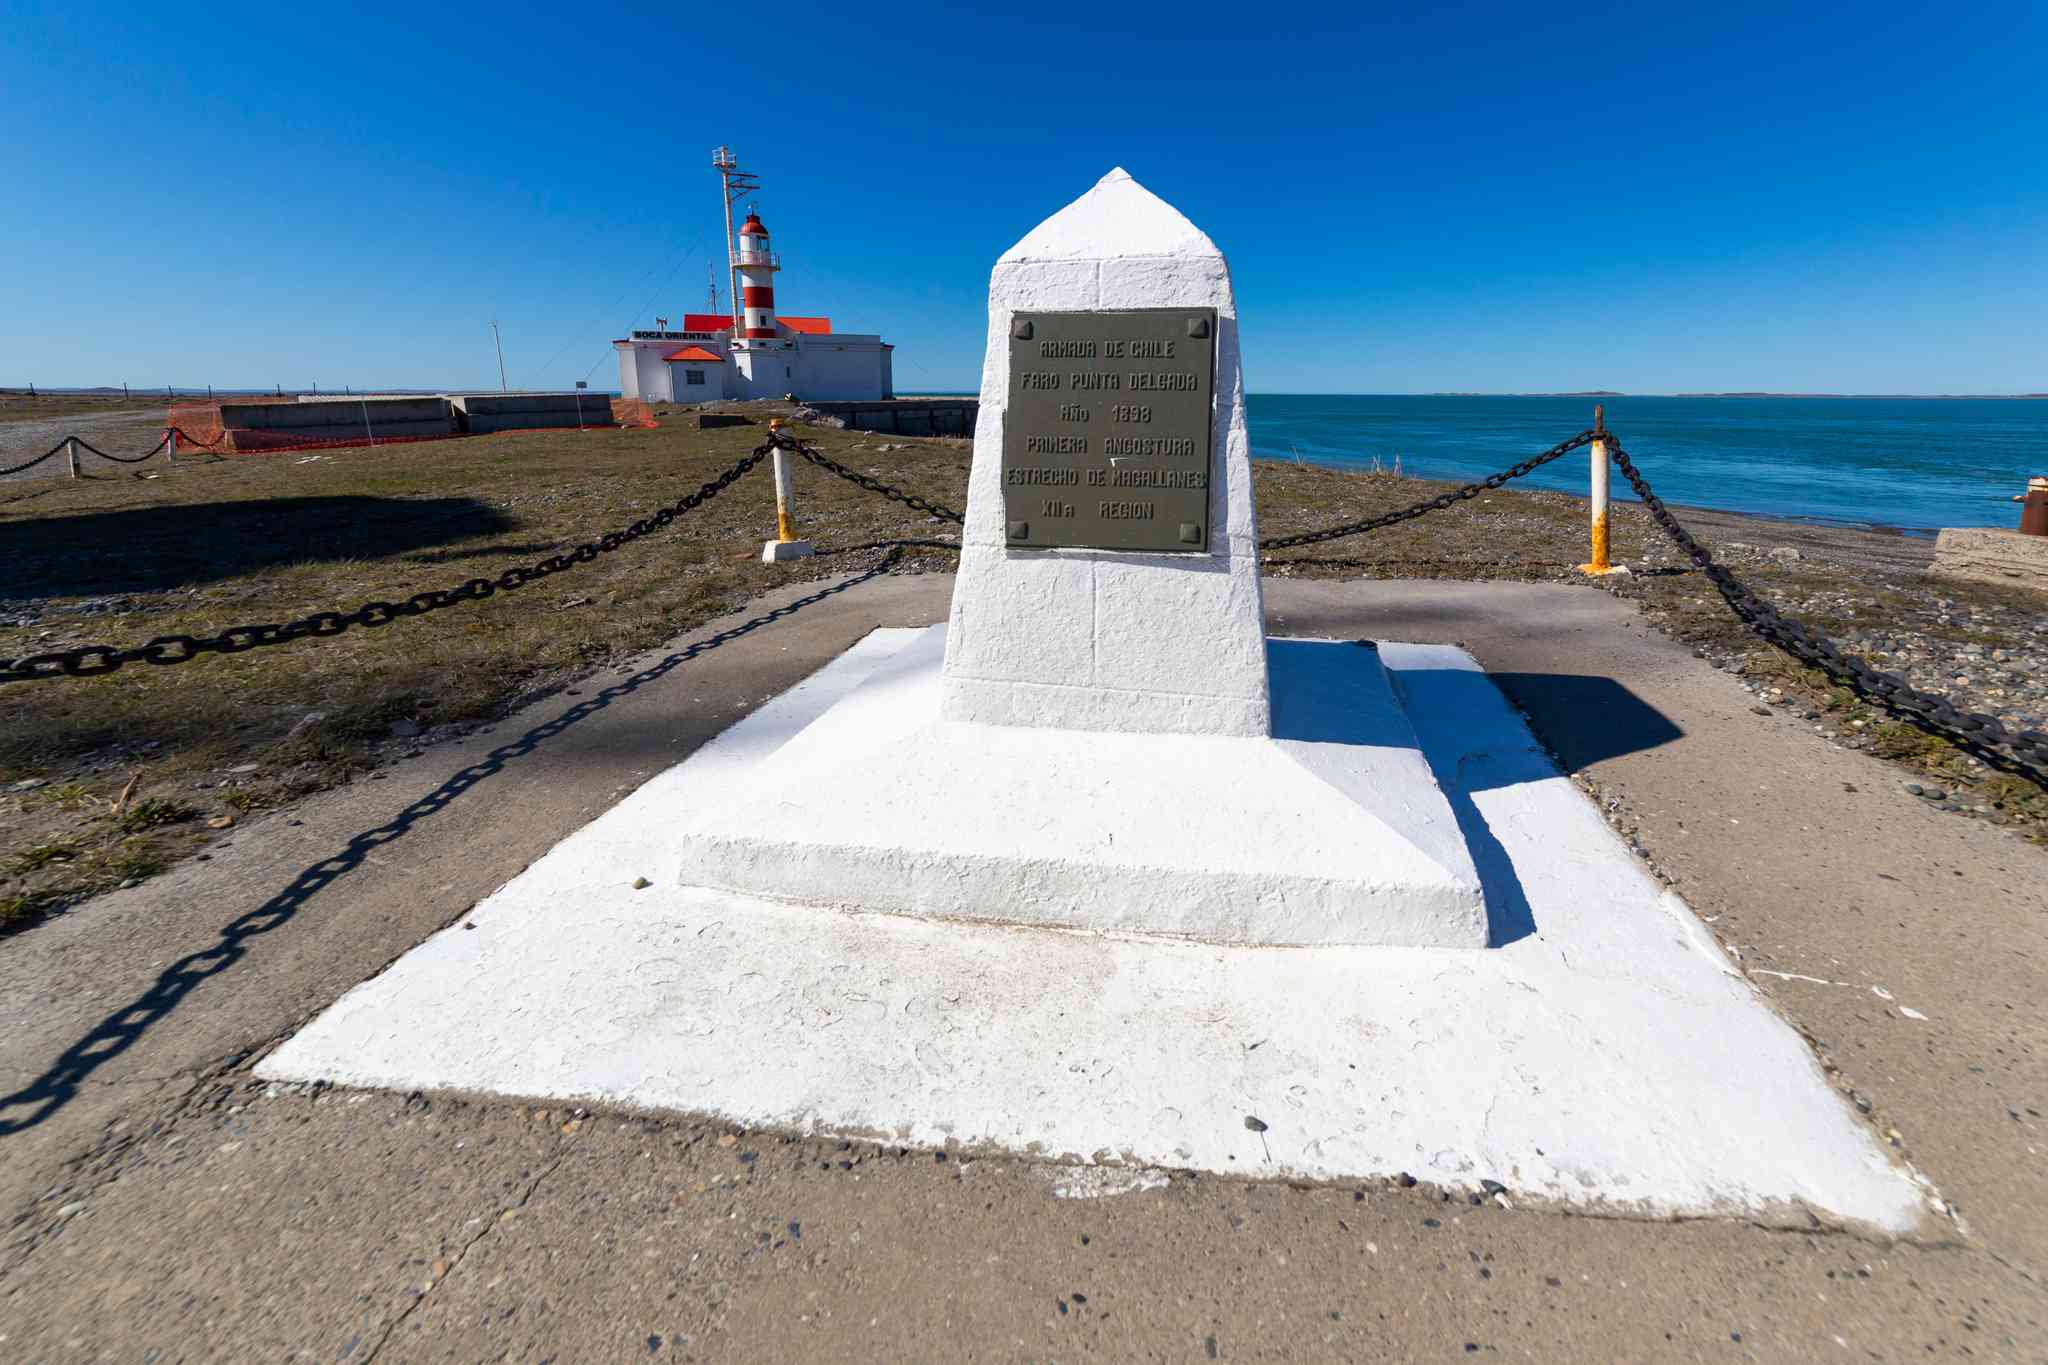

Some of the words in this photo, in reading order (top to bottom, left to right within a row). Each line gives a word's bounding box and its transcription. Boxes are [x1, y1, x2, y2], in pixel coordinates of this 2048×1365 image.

[634, 331, 662, 339] BOCA
[665, 331, 713, 340] ORIENTAL
[1040, 340, 1096, 358] ARMADA
[1104, 341, 1125, 358] DE
[1130, 341, 1176, 358] CHILE
[1021, 373, 1060, 389] FARO
[1071, 373, 1120, 389] PUNTA
[1129, 373, 1198, 391] DELGADA
[1027, 436, 1088, 454] PRIMERA
[1104, 438, 1194, 456] ANGOSTURA
[1007, 468, 1079, 486] ESTRECHO
[1087, 469, 1106, 487] DE
[1112, 469, 1207, 488] MAGALLANES
